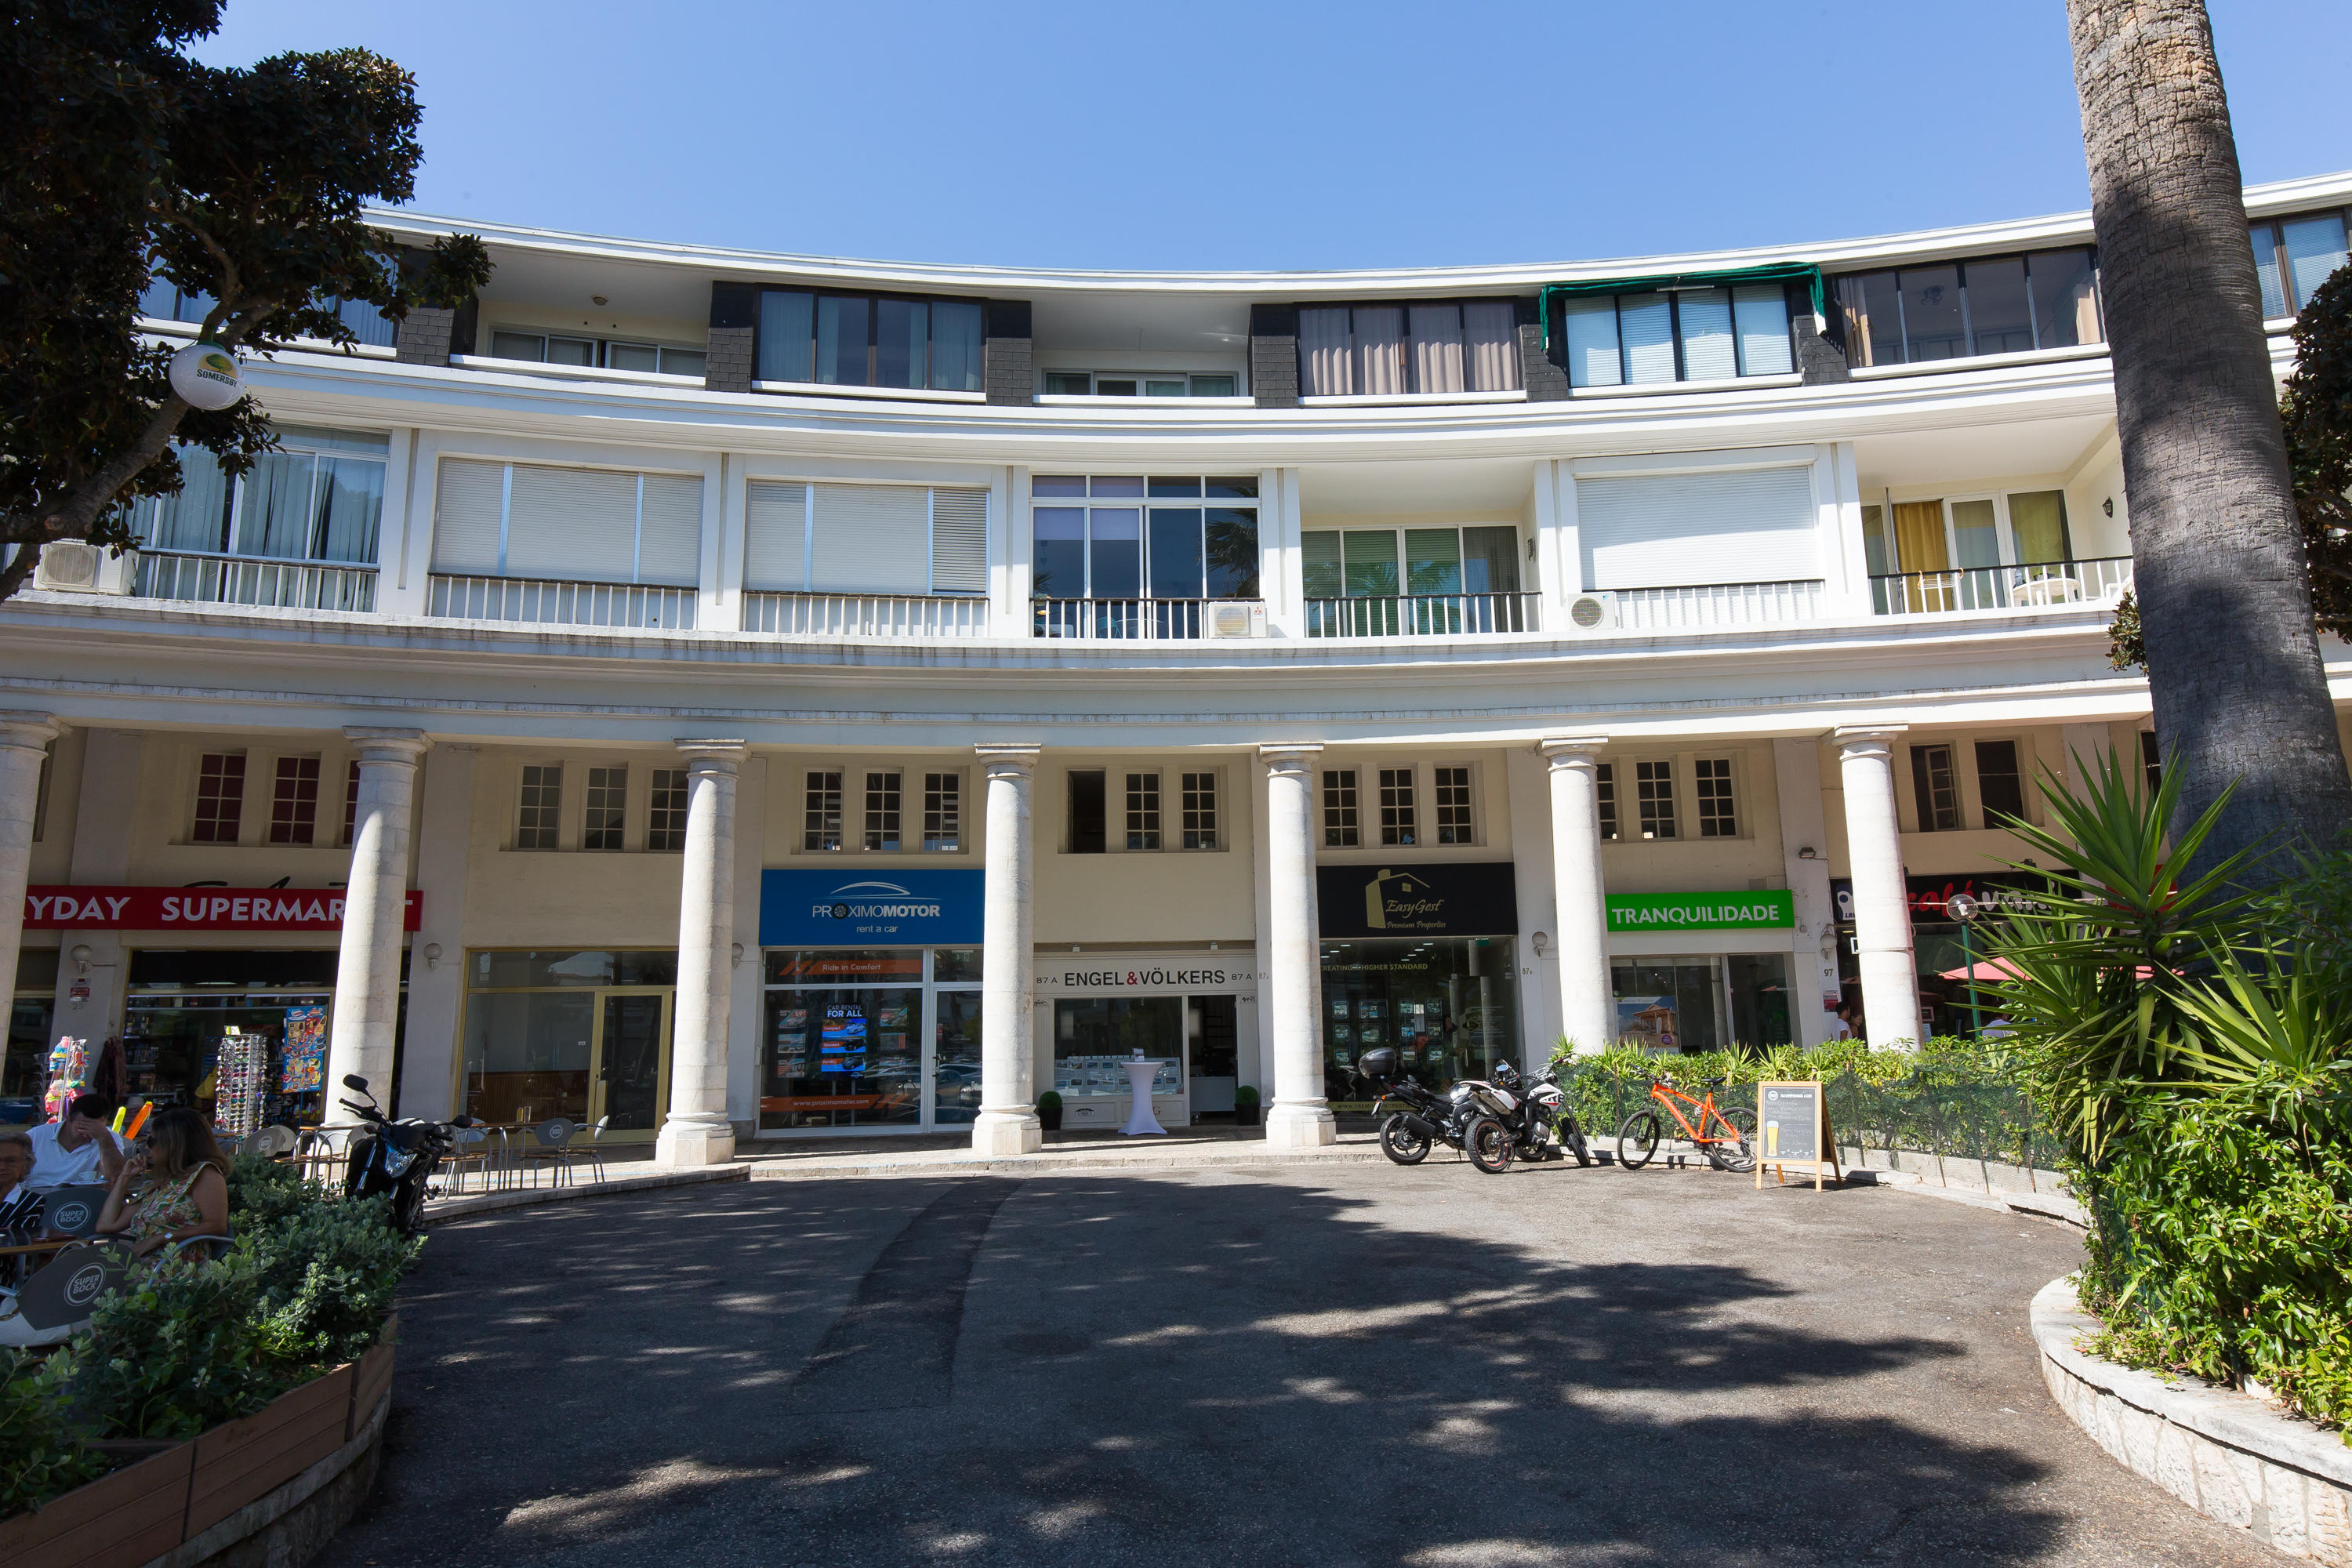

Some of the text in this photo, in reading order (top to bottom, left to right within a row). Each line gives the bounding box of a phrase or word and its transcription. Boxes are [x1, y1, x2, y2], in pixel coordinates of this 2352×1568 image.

[196, 368, 238, 387] SOMERSBY
[24, 896, 413, 922] YDAY SUPERMAR
[812, 902, 941, 919] PROXIMOMOTOR
[1612, 905, 1780, 925] TRANQUILIDADE
[856, 924, 873, 933] rent
[1416, 920, 1446, 931] Properties
[1824, 968, 1834, 977] 97
[74, 1274, 100, 1286] SUPER
[73, 1282, 96, 1294] BOCK
